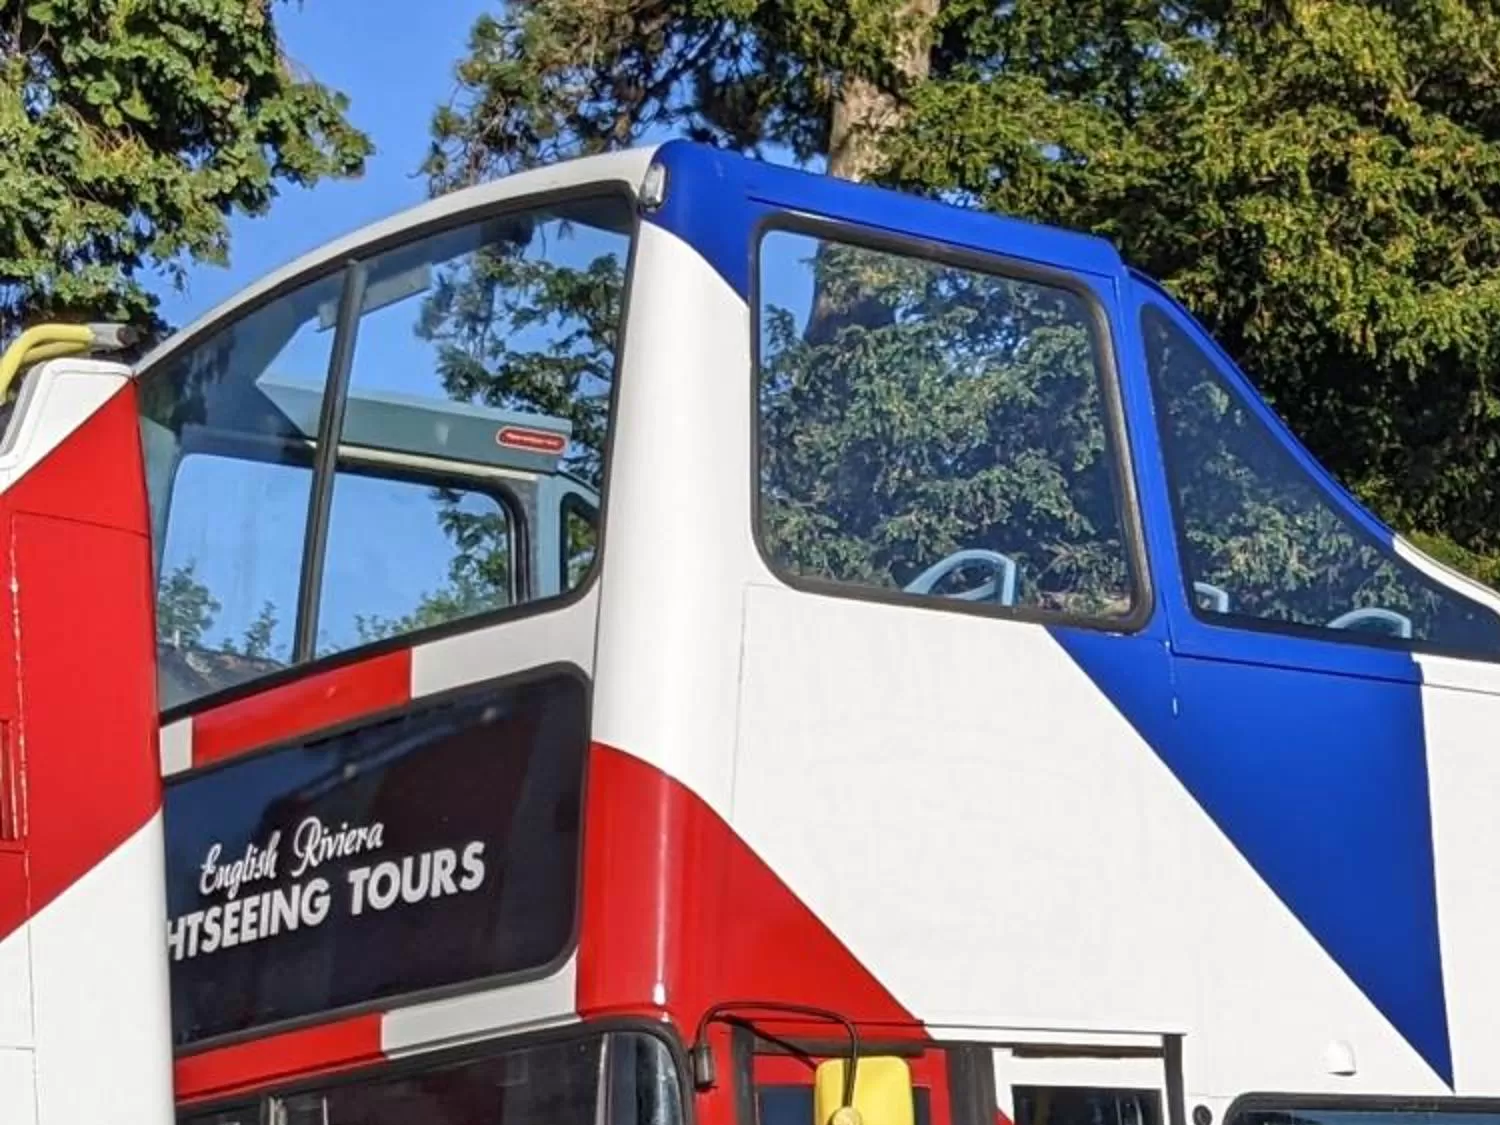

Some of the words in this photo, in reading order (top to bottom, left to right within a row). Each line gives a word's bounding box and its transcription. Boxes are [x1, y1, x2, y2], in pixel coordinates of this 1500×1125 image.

[200, 830, 281, 899] English
[292, 816, 384, 877] Riviera
[348, 841, 485, 915] TOURS
